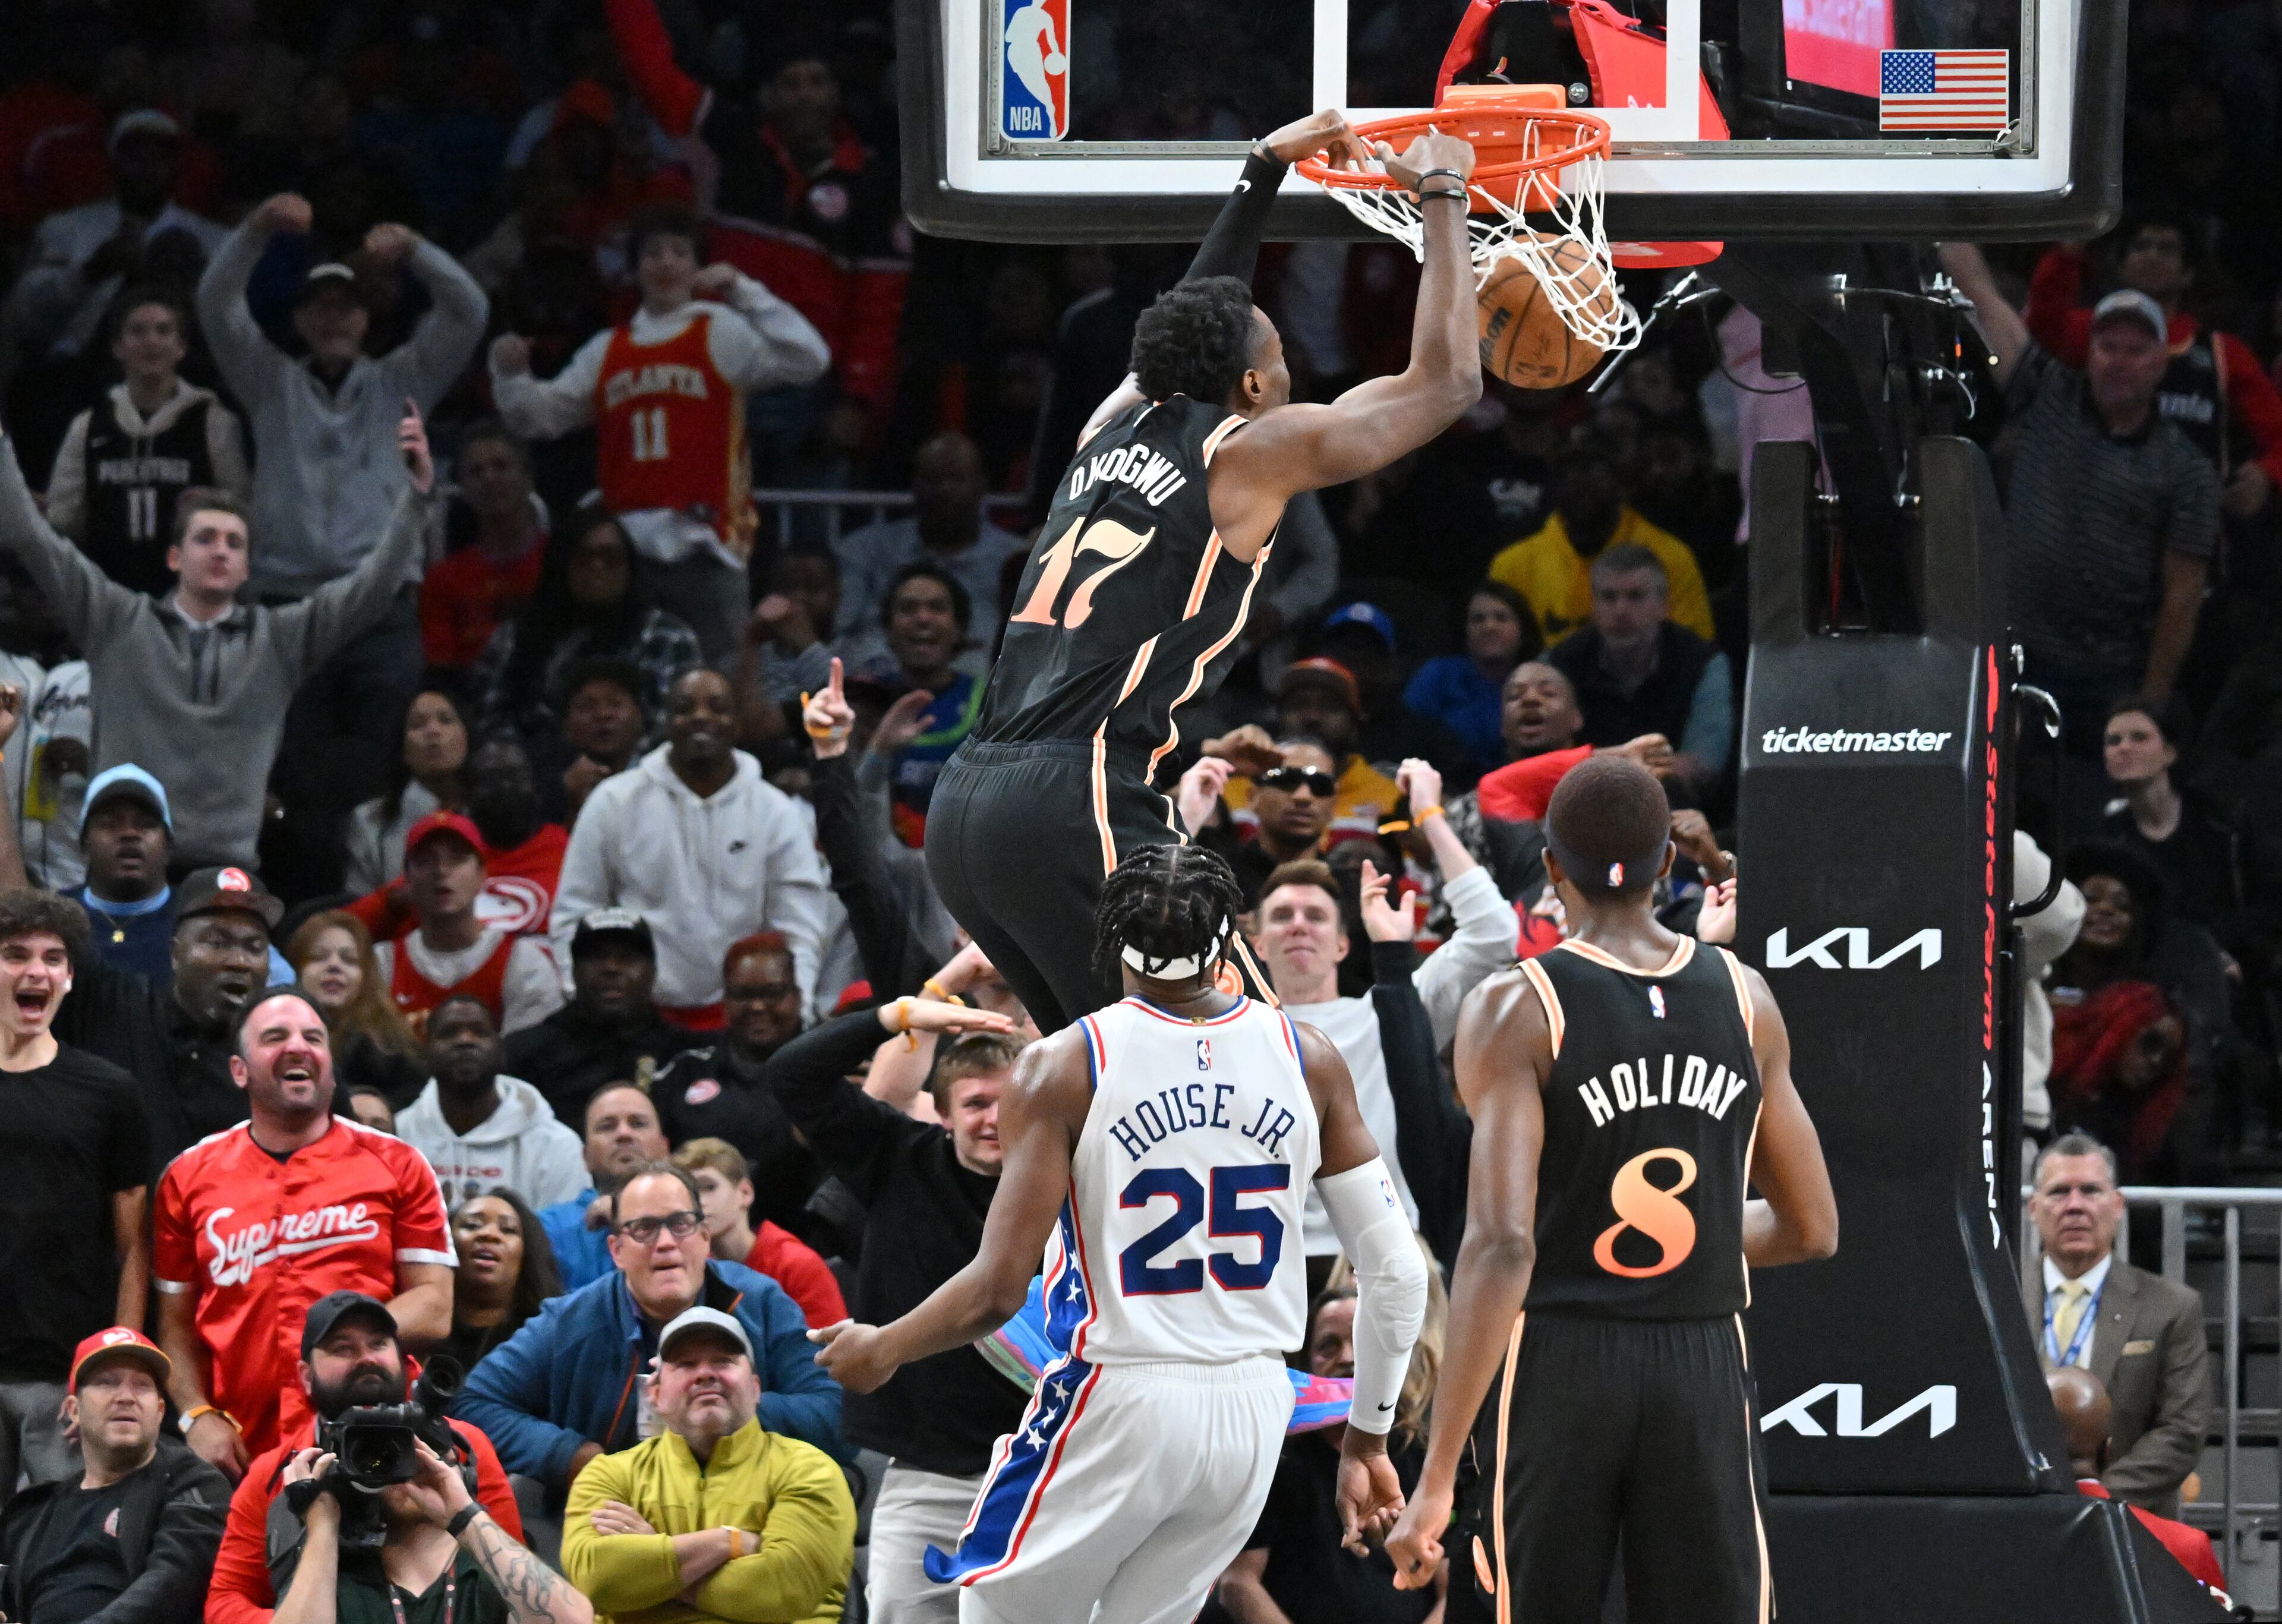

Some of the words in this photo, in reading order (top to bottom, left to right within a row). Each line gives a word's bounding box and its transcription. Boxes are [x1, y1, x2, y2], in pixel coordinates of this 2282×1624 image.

[1010, 106, 1041, 131] NBA
[632, 406, 670, 462] 11
[128, 487, 159, 541] 11
[1010, 516, 1158, 630] 17
[1763, 726, 1952, 753] ticketmaster
[1766, 927, 1942, 970] KIA
[1109, 1083, 1234, 1162] HOUSE
[1578, 1054, 1747, 1127] HOLIDAY
[1982, 1060, 2000, 1250] ARENA
[206, 1203, 379, 1286] Supreme
[1119, 1163, 1291, 1297] 25
[1593, 1147, 1697, 1278] 8
